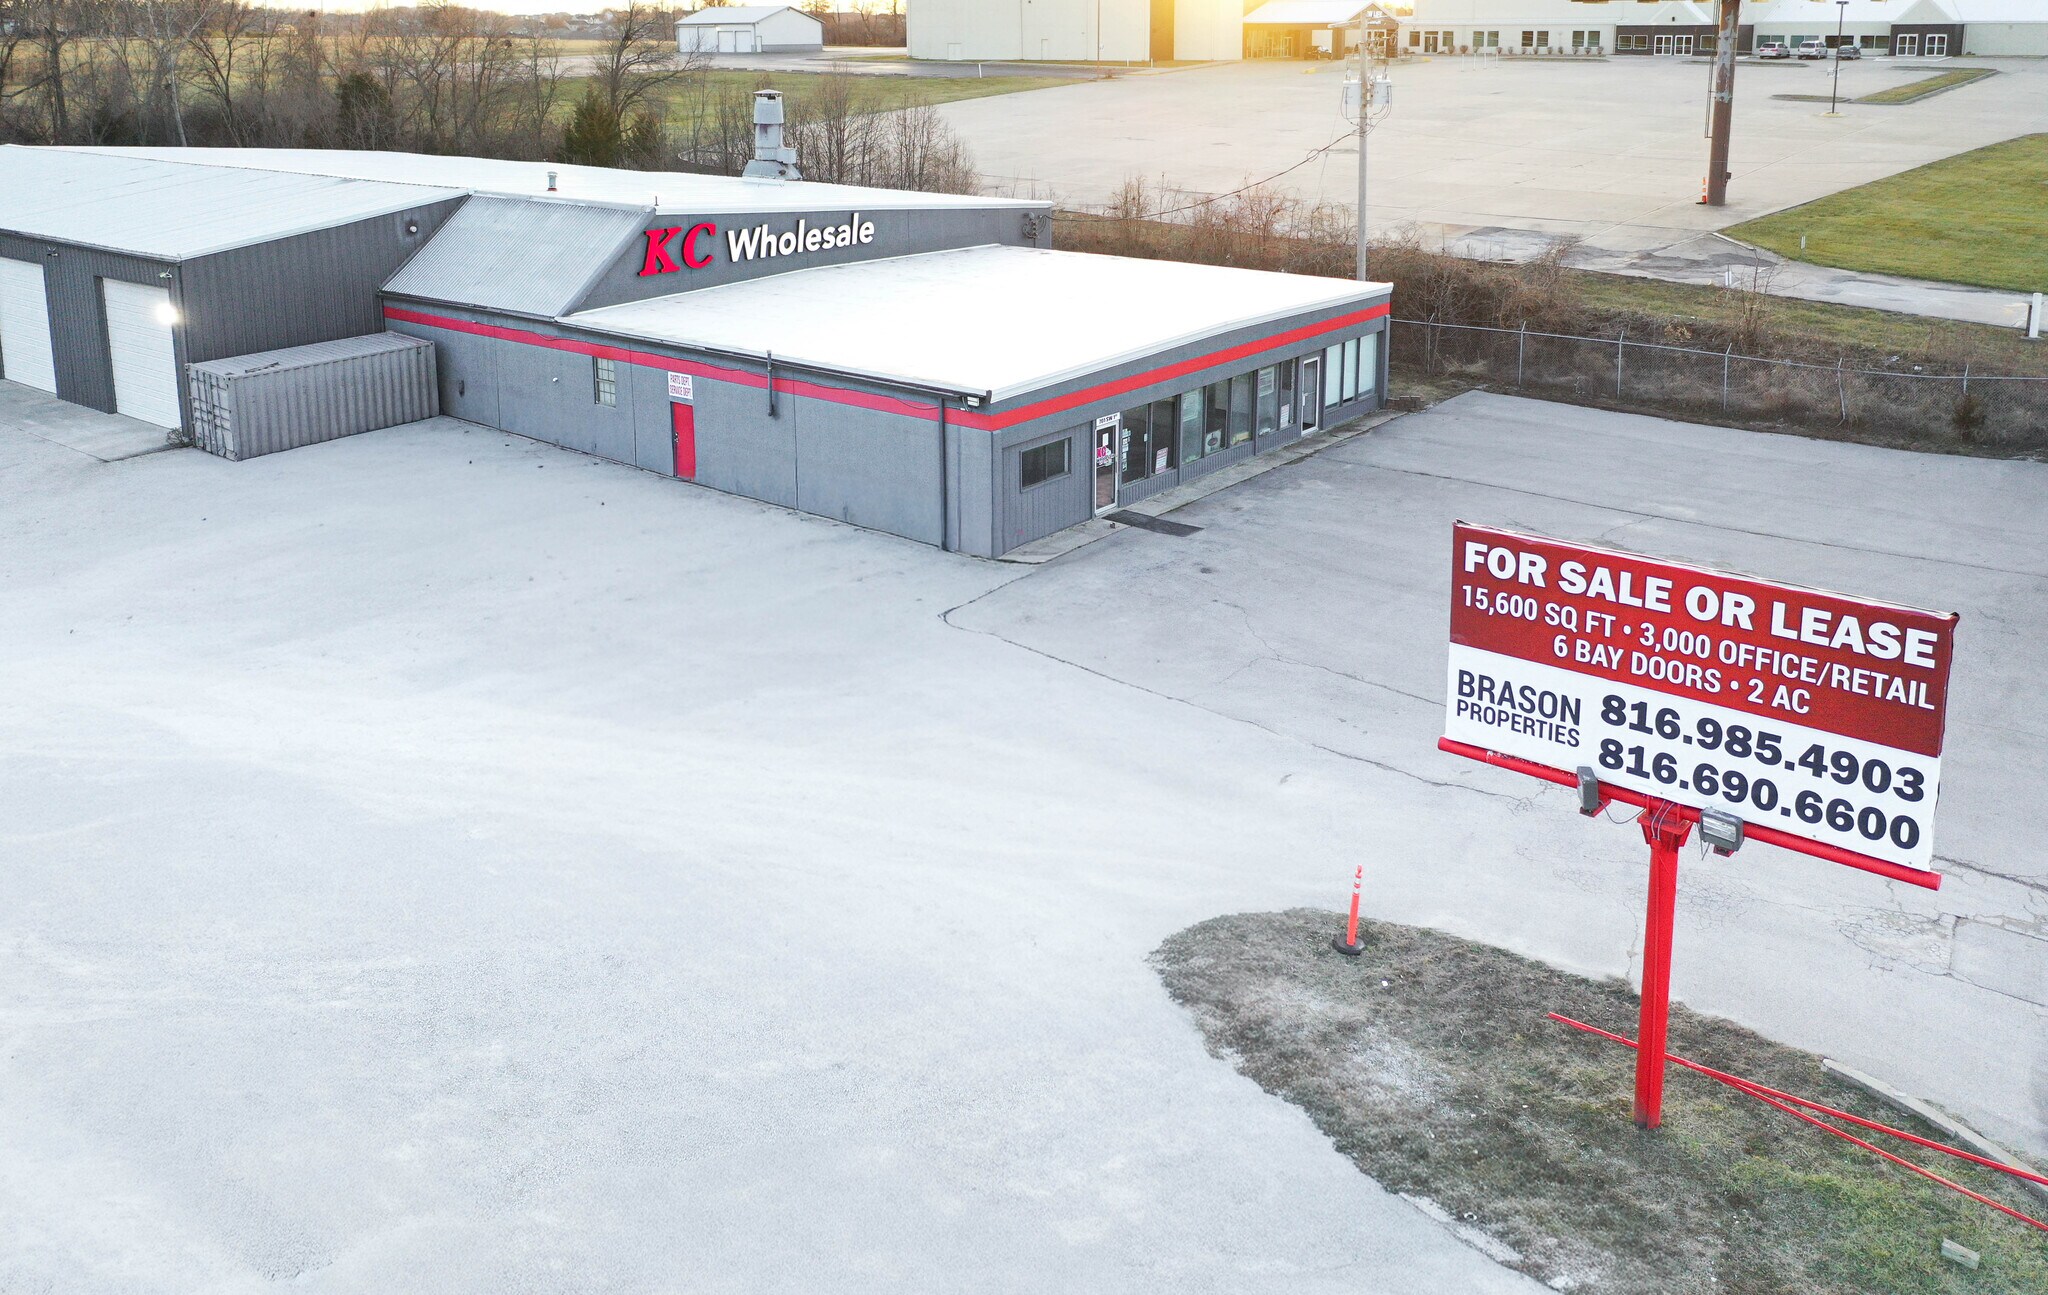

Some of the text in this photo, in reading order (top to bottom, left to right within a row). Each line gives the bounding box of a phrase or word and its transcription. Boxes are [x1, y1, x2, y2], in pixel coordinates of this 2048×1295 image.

[638, 212, 875, 277] KC Wholesale
[1463, 585, 1935, 711] 15,600 SQ FT 3,000 OFFICE/RETAIL
[1464, 541, 1938, 669] FOR SALE OR LEASE
[1457, 669, 1581, 726] BRASON
[1553, 639, 1811, 715] 6 BAY DOORS 2 AC
[1457, 701, 1580, 748] PROPERTIES
[1600, 695, 1925, 802] 816.985.4903
[1598, 738, 1920, 850] 816.690.6600
